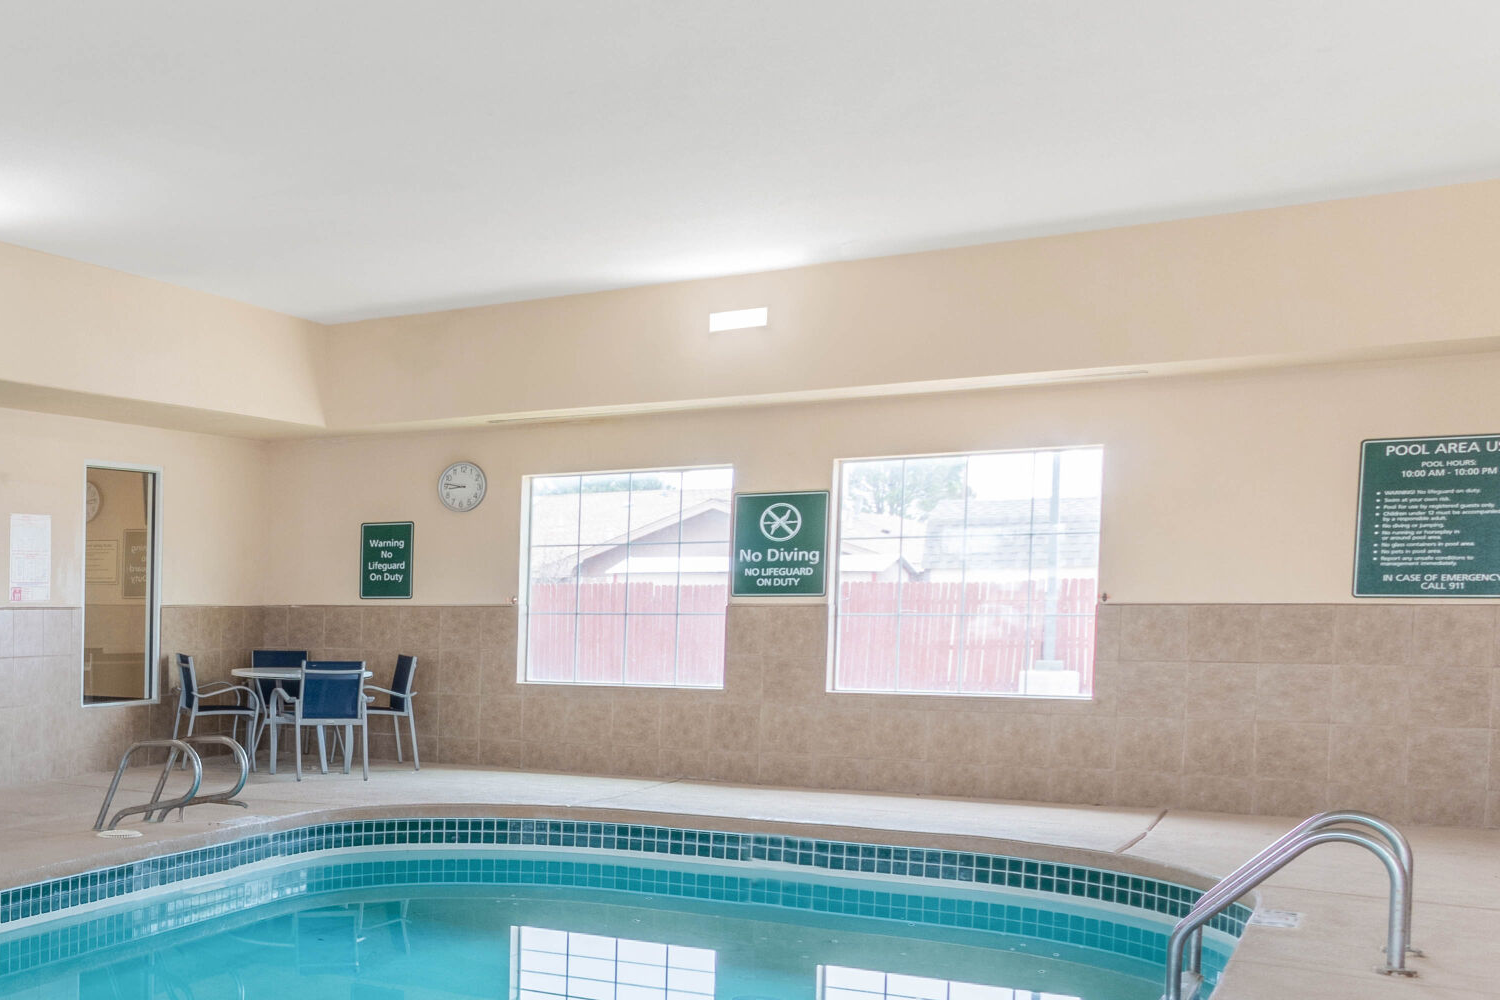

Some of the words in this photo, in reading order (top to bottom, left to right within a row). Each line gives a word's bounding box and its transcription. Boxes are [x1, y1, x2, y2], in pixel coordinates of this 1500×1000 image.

[1385, 444, 1430, 456] POOL
[1434, 442, 1481, 454] AREA
[1421, 460, 1444, 468] POOL
[1446, 459, 1477, 467] HOURS:
[1401, 470, 1426, 478] 10:00
[1428, 469, 1445, 477] AM
[1454, 468, 1480, 476] 10:00
[1481, 467, 1498, 475] PM
[369, 539, 405, 549] Warning
[380, 550, 393, 559] No
[740, 549, 762, 562] No
[767, 547, 820, 565] Diving
[368, 561, 405, 571] Lifeguard
[744, 568, 760, 576] NO
[761, 567, 814, 576] LIFEGUARD
[369, 573, 382, 582] On
[383, 573, 404, 583] Duty
[756, 578, 771, 587] ON
[773, 578, 801, 586] DUTY
[1382, 574, 1393, 582] IN
[1395, 574, 1421, 582] CASE
[1424, 574, 1438, 582] OF
[1421, 582, 1446, 590] CALL
